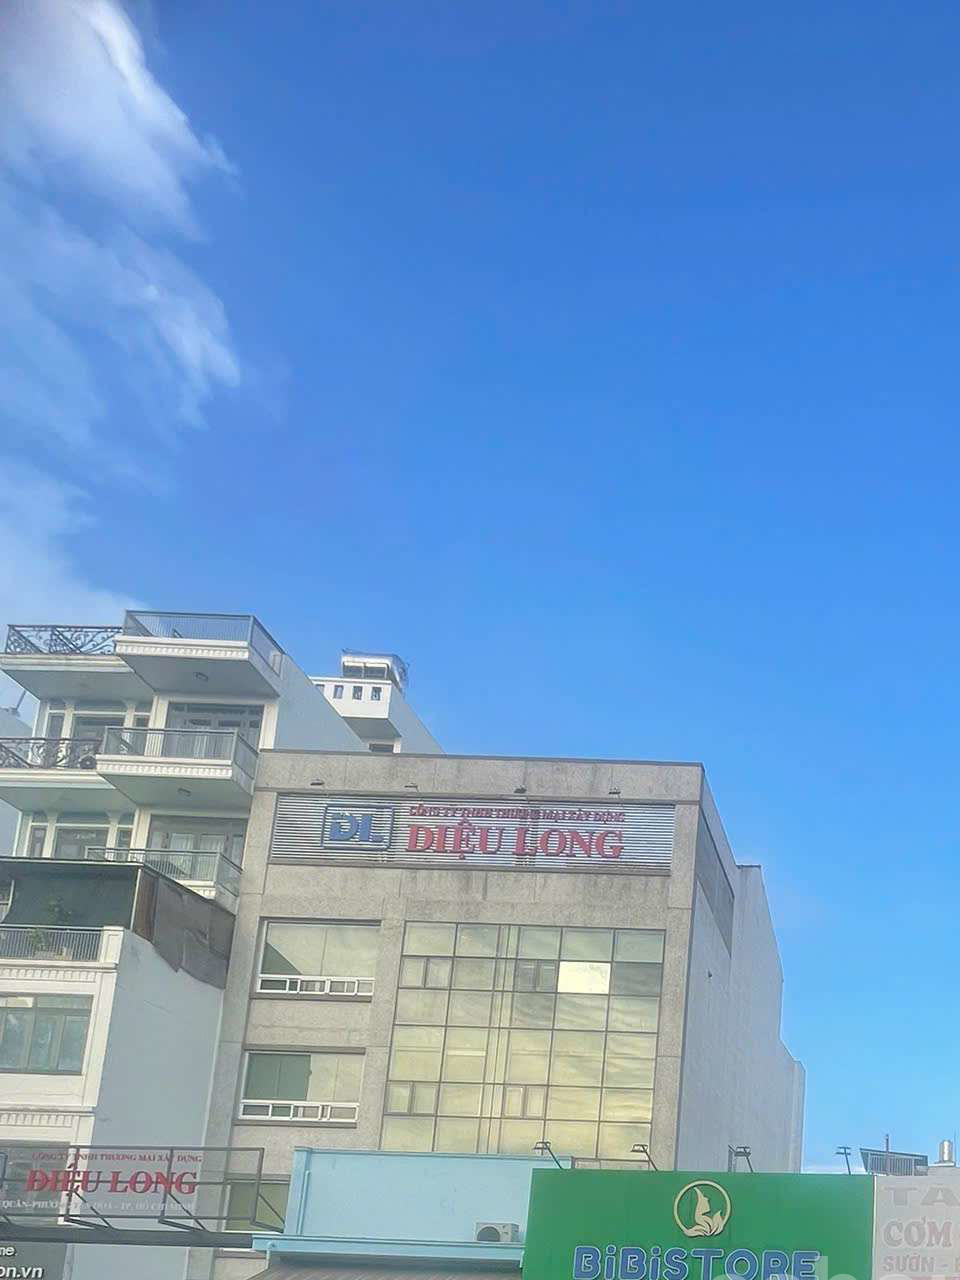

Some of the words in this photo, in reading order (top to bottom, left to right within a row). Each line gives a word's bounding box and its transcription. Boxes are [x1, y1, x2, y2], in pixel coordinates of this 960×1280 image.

[406, 818, 502, 860] DIỆU
[512, 827, 624, 858] LONG
[108, 1170, 197, 1195] LONG
[883, 1218, 952, 1248] CƠM
